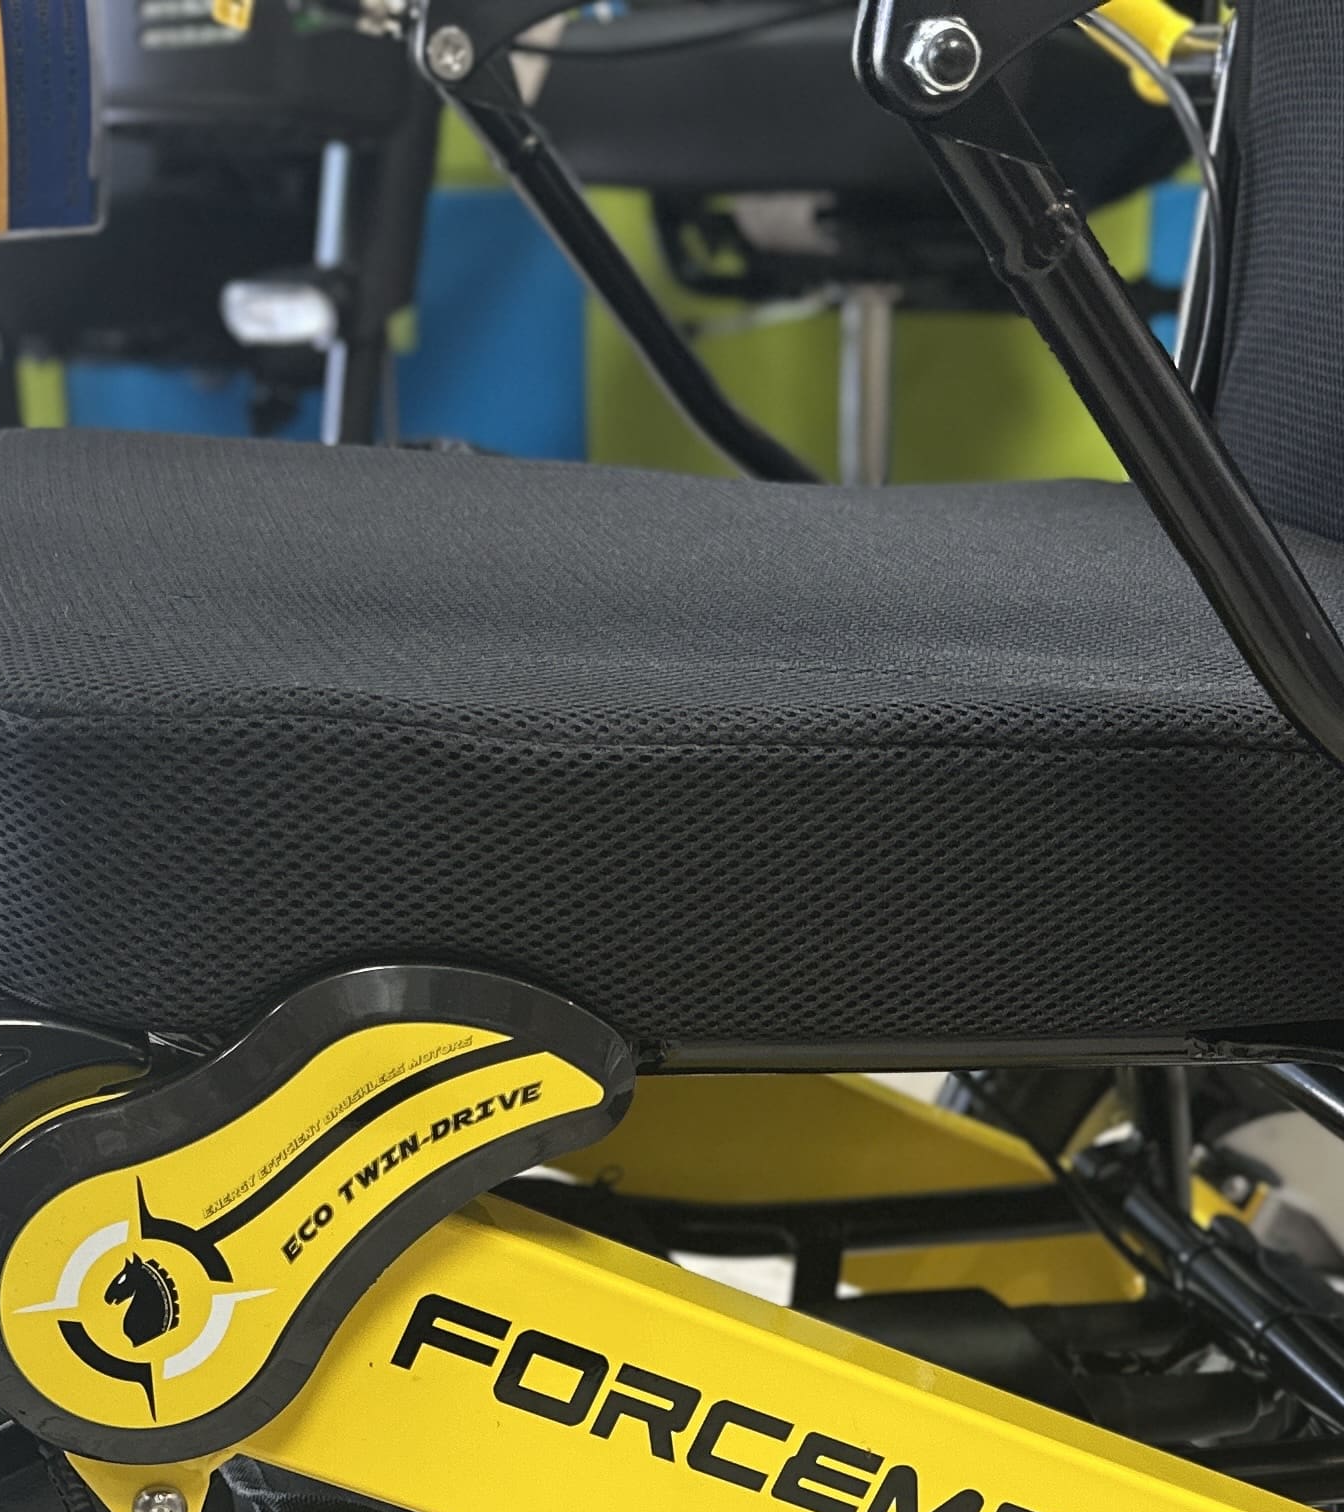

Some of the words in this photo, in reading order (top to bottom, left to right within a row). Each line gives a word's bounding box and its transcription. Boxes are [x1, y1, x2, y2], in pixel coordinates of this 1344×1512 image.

[201, 1175, 256, 1219] ENERGY
[258, 1117, 322, 1181] EFFICIENT
[324, 1063, 406, 1124] BRUSHLESS
[408, 1035, 474, 1071] MOTORS
[280, 1202, 334, 1264] ECO
[337, 1080, 543, 1204] TWIN-DRIVE
